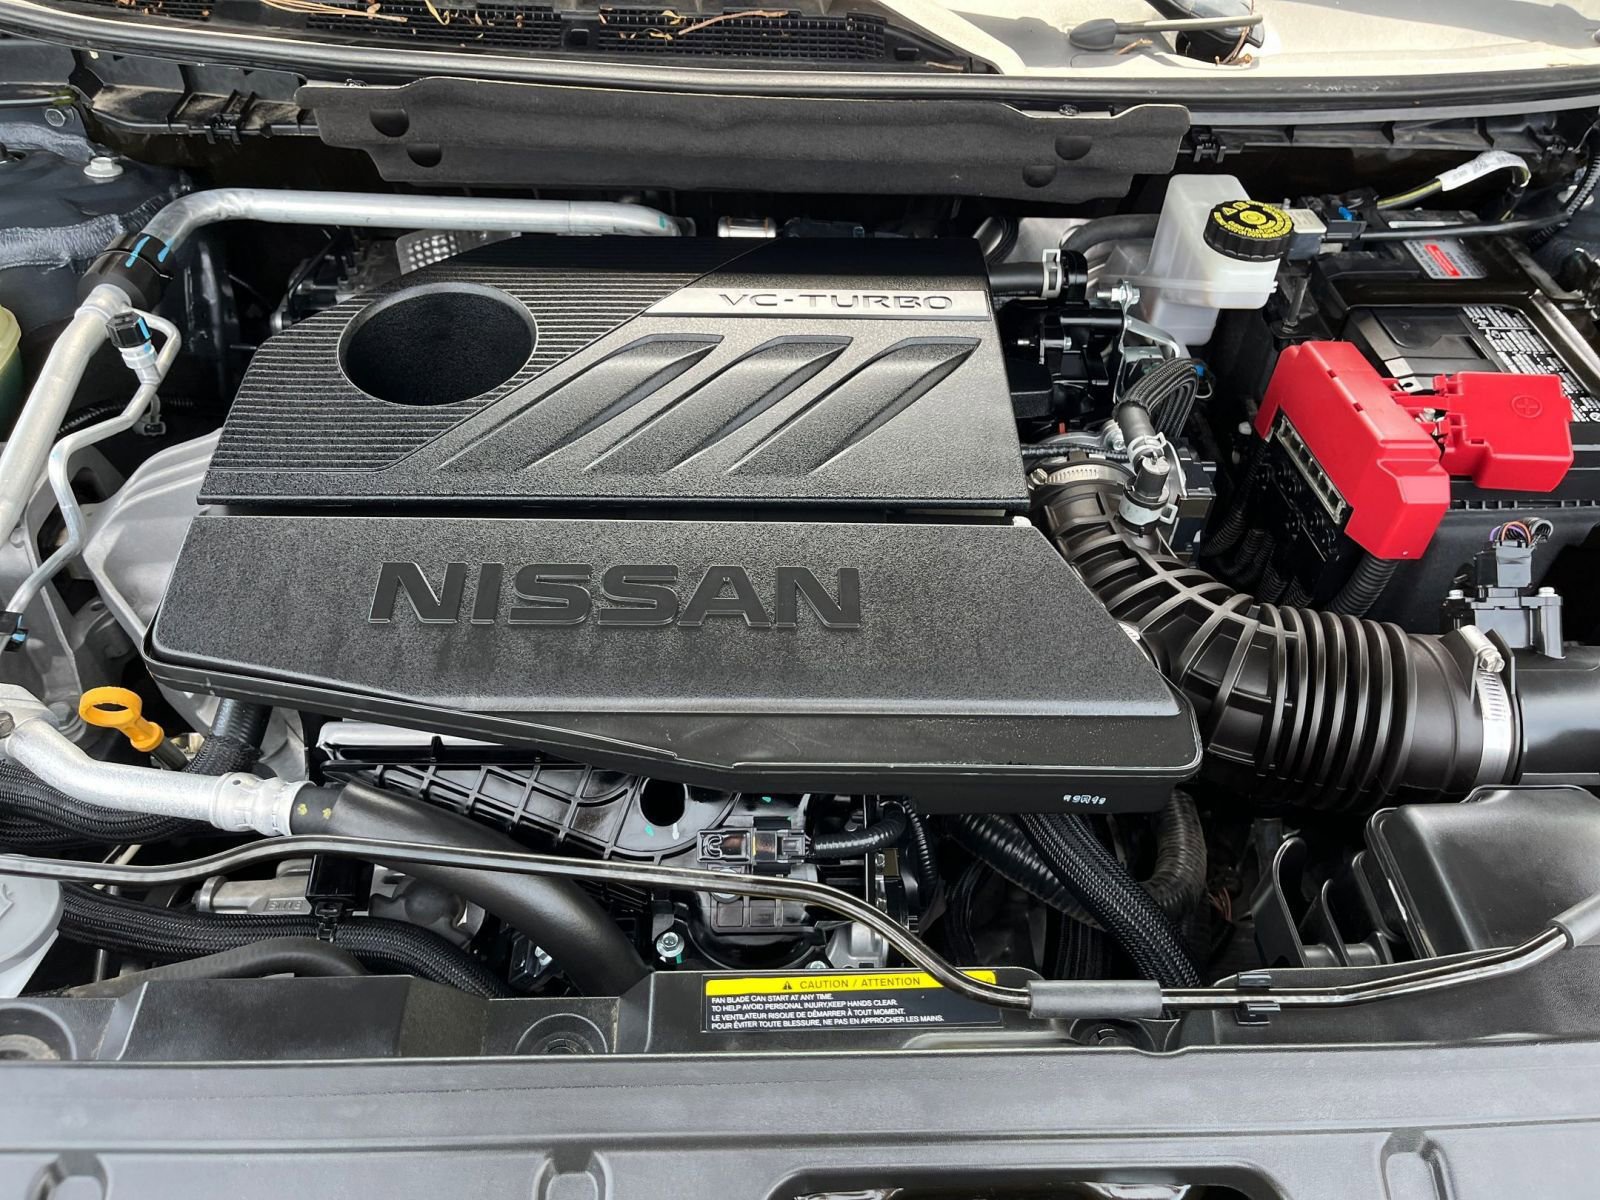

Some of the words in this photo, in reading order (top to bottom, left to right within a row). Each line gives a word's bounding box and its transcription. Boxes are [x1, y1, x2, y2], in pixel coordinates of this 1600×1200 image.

[718, 292, 954, 310] VC-TURBO
[368, 561, 861, 628] NISSAN
[800, 980, 849, 989] CAUTION
[861, 977, 920, 987] ATTENTION
[765, 1002, 803, 1010] PERSONAL
[712, 1014, 720, 1022] LE
[721, 1013, 767, 1021] VENTILATEUR
[768, 1011, 795, 1019] RISQUE
[807, 1009, 846, 1018] DÉMARRER
[847, 1008, 853, 1016] À
[734, 1020, 758, 1029] ÉVITER
[783, 1019, 821, 1027] BLESSURE,
[860, 1016, 905, 1024] APPROCHER
[906, 1015, 919, 1023] LES
[920, 1014, 944, 1022] MAINS.
